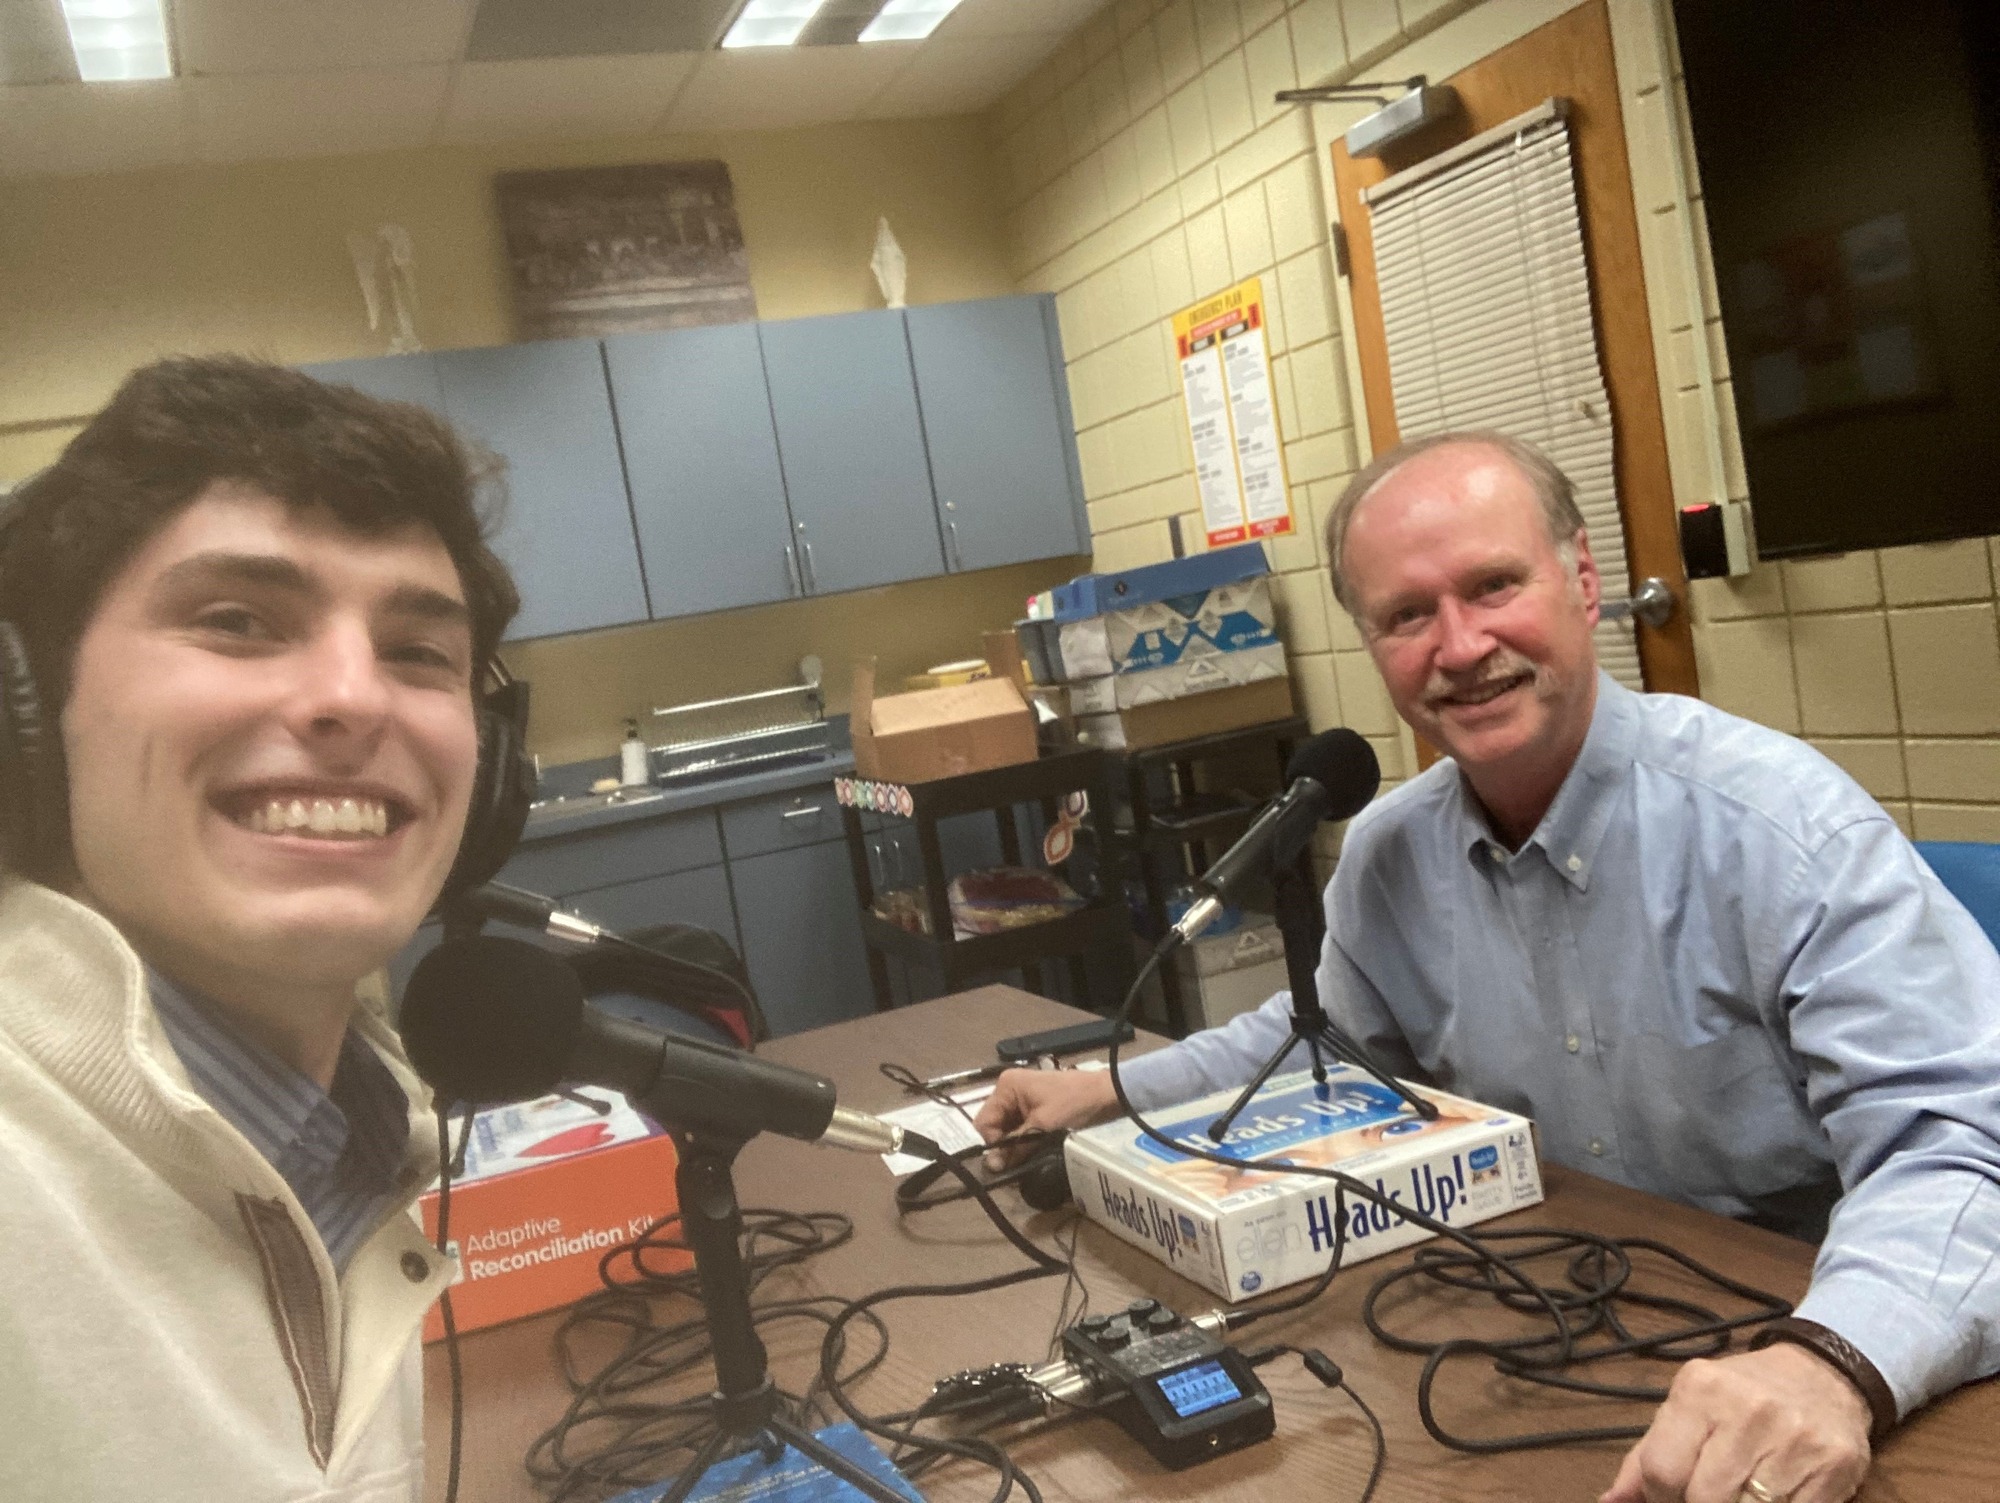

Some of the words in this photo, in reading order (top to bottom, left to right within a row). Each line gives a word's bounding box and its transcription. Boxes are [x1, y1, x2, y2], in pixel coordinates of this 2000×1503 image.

[1098, 1170, 1150, 1239] Heads
[1147, 1197, 1183, 1263] Up!
[1305, 1178, 1406, 1253] Hads
[1411, 1154, 1467, 1222] Up!
[466, 1215, 561, 1255] Adaptive
[469, 1226, 624, 1281] Reconciliation
[1236, 1222, 1302, 1264] ellen
